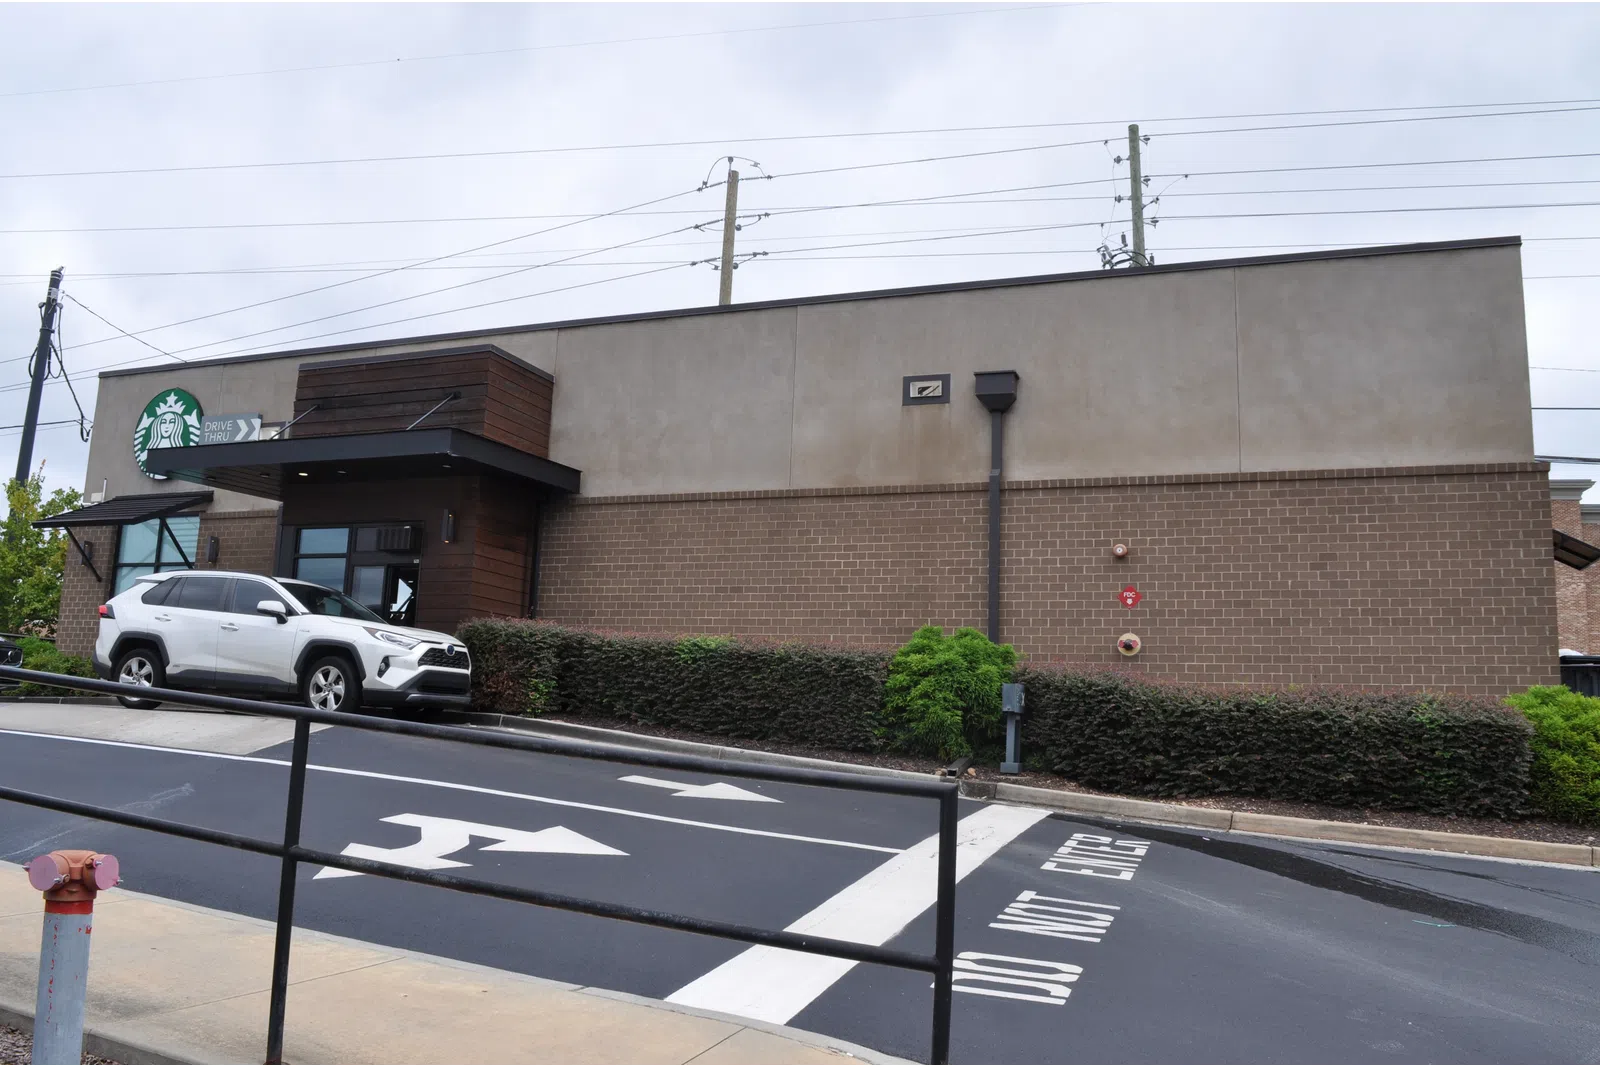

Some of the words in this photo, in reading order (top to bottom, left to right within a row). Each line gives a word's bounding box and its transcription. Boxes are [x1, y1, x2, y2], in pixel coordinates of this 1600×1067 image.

[204, 420, 233, 432] DRIVE
[204, 431, 230, 442] THRU
[1040, 833, 1151, 881] ENTER
[988, 890, 1121, 943] NOT
[930, 951, 1084, 1006] DO
